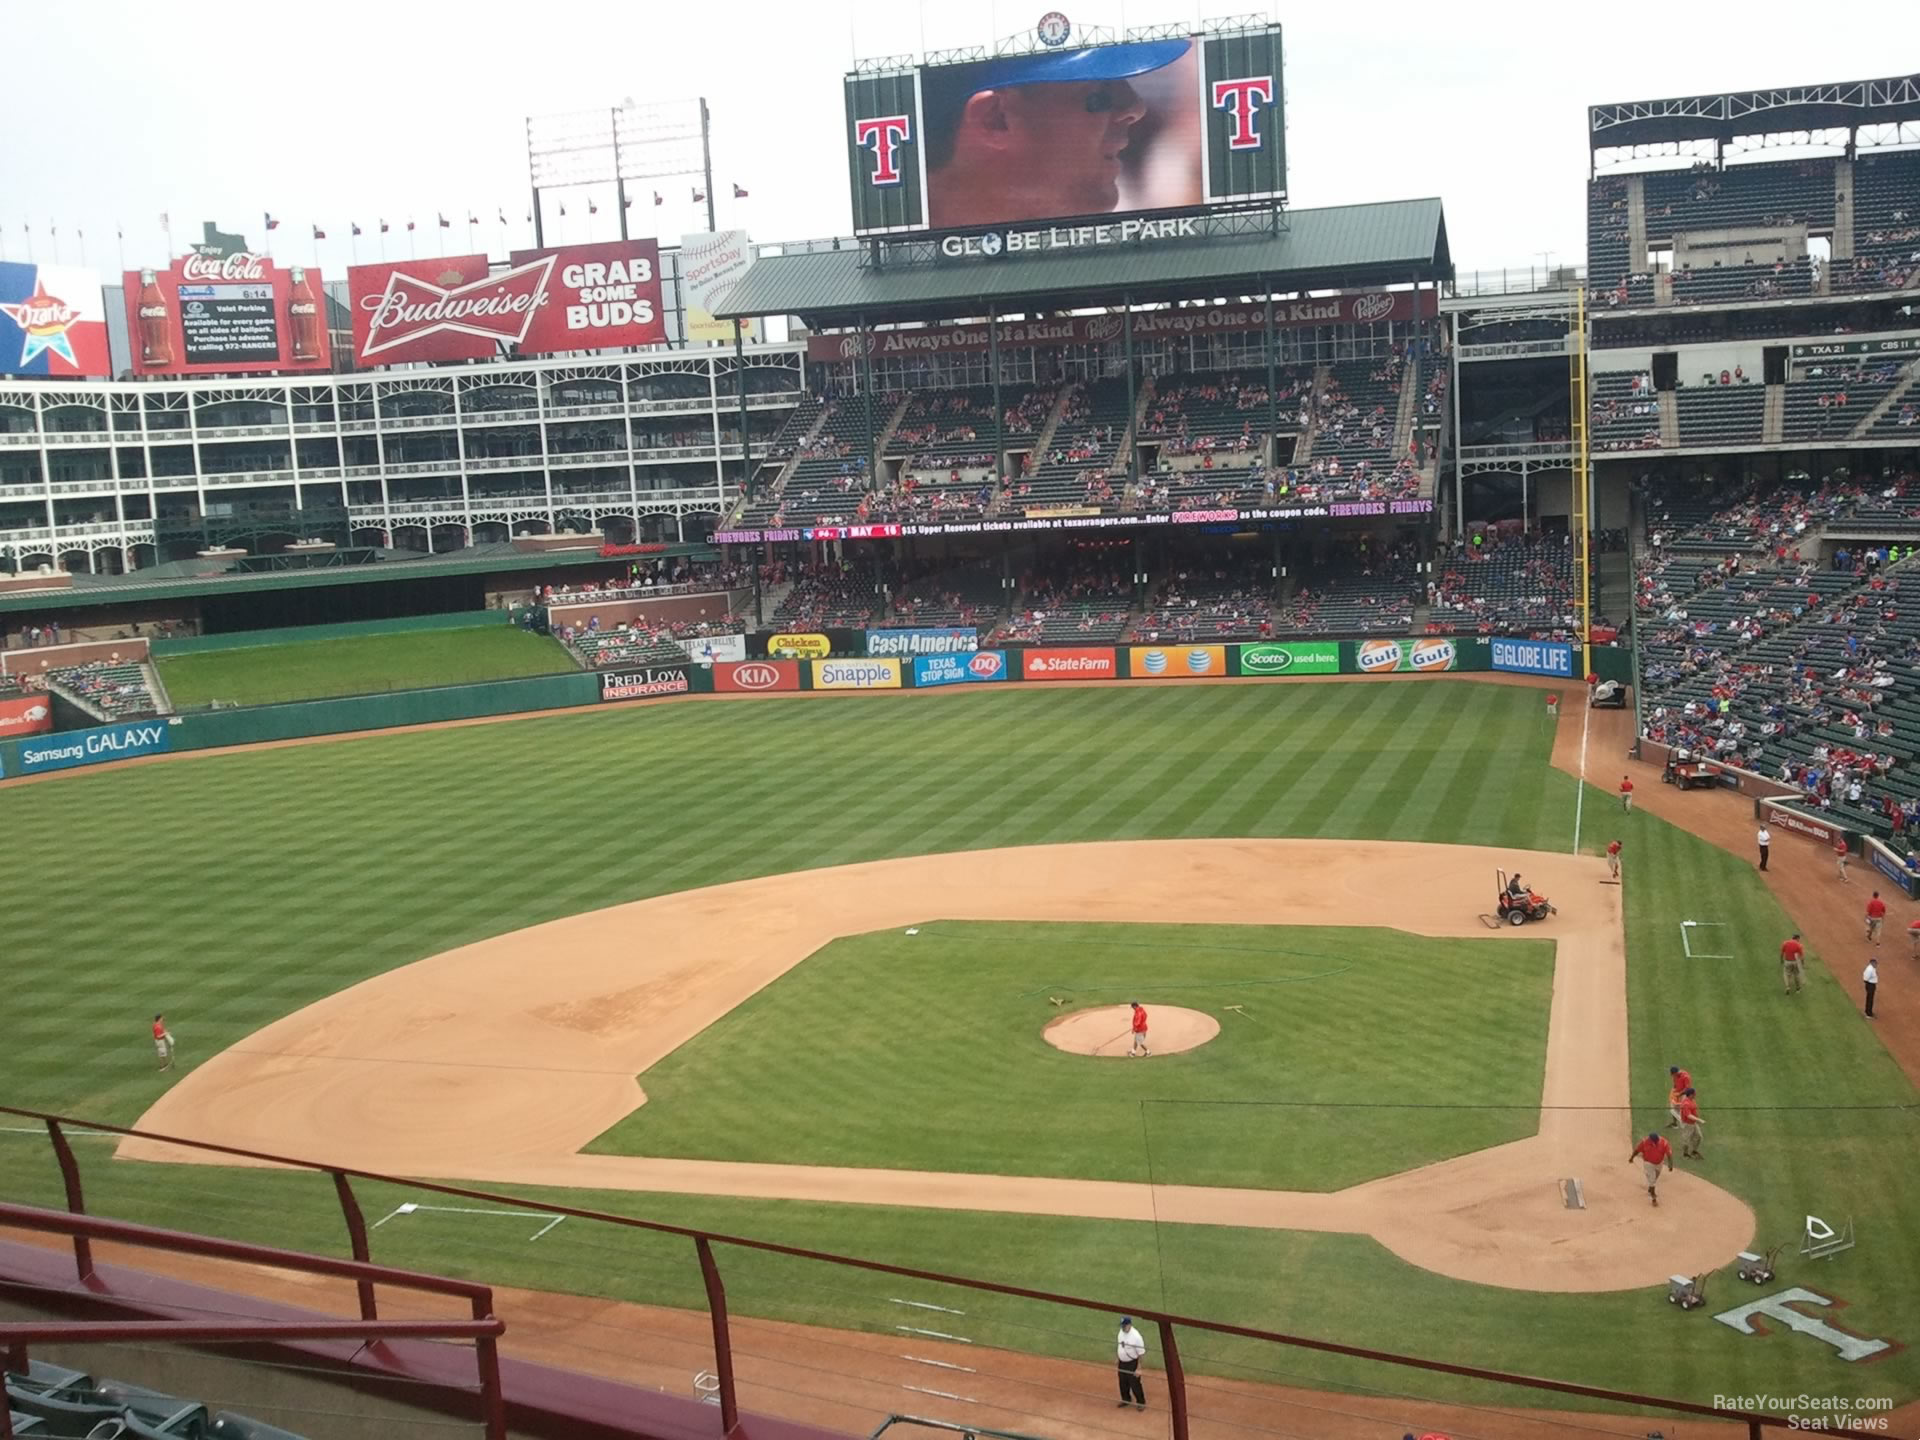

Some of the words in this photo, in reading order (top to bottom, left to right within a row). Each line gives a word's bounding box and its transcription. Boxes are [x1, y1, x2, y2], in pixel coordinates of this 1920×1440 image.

[1212, 76, 1276, 152] T
[855, 115, 911, 187] T
[1050, 226, 1111, 248] LIFE
[1121, 217, 1197, 241] PARK
[562, 258, 652, 289] GRAB
[686, 248, 741, 282] SportsDay
[243, 290, 267, 298] 6:14
[579, 285, 637, 304] SOME
[16, 303, 72, 329] Ozarka
[238, 304, 266, 312] Parking
[361, 286, 549, 328] Budweiser
[567, 300, 654, 330] BUDS
[254, 318, 275, 326] game
[1133, 310, 1206, 333] Always
[1208, 310, 1246, 327] One
[1276, 311, 1287, 322] a
[1290, 304, 1340, 321] Kind
[187, 344, 196, 352] by
[198, 343, 224, 351] calling
[224, 341, 277, 350] 972-RANGERS
[883, 333, 950, 352] Always
[952, 329, 989, 345] One
[1015, 330, 1024, 341] a
[1026, 322, 1074, 340] Kind
[1881, 342, 1899, 350] CBS
[1811, 346, 1832, 354] TXA
[1834, 345, 1845, 353] 21
[1330, 503, 1385, 516] FIREWORKS
[1390, 500, 1432, 513] FRIDAYS
[850, 526, 873, 537] MAY
[919, 525, 942, 535] Upper
[944, 523, 981, 533] Reserved
[983, 521, 1011, 531] tickets
[1013, 519, 1050, 530] available
[1053, 519, 1062, 528] at
[1172, 510, 1237, 523] FIREWORKS
[1240, 511, 1250, 519] as
[1252, 509, 1268, 519] the
[1269, 509, 1301, 519] coupon
[714, 531, 760, 543] FIREWORKS
[764, 529, 800, 542] FRIDAYS
[777, 638, 821, 648] Chicken
[928, 657, 956, 670] TEXAS
[974, 659, 997, 671] DQ
[1249, 651, 1286, 666] Scotts
[1294, 652, 1313, 664] used
[1362, 648, 1398, 667] Gulf
[1412, 646, 1450, 666] Gulf
[1505, 645, 1541, 668] GLOBE
[1543, 647, 1568, 671] LIFE
[603, 673, 643, 688] FRED
[646, 669, 686, 684] LOYA
[740, 669, 772, 683] KIA
[822, 663, 891, 686] Snapple
[921, 671, 943, 682] STOP
[943, 667, 964, 680] SIGN
[605, 682, 686, 698] INSURANCE
[24, 743, 83, 764] Samsung
[86, 726, 162, 754] GALAXY
